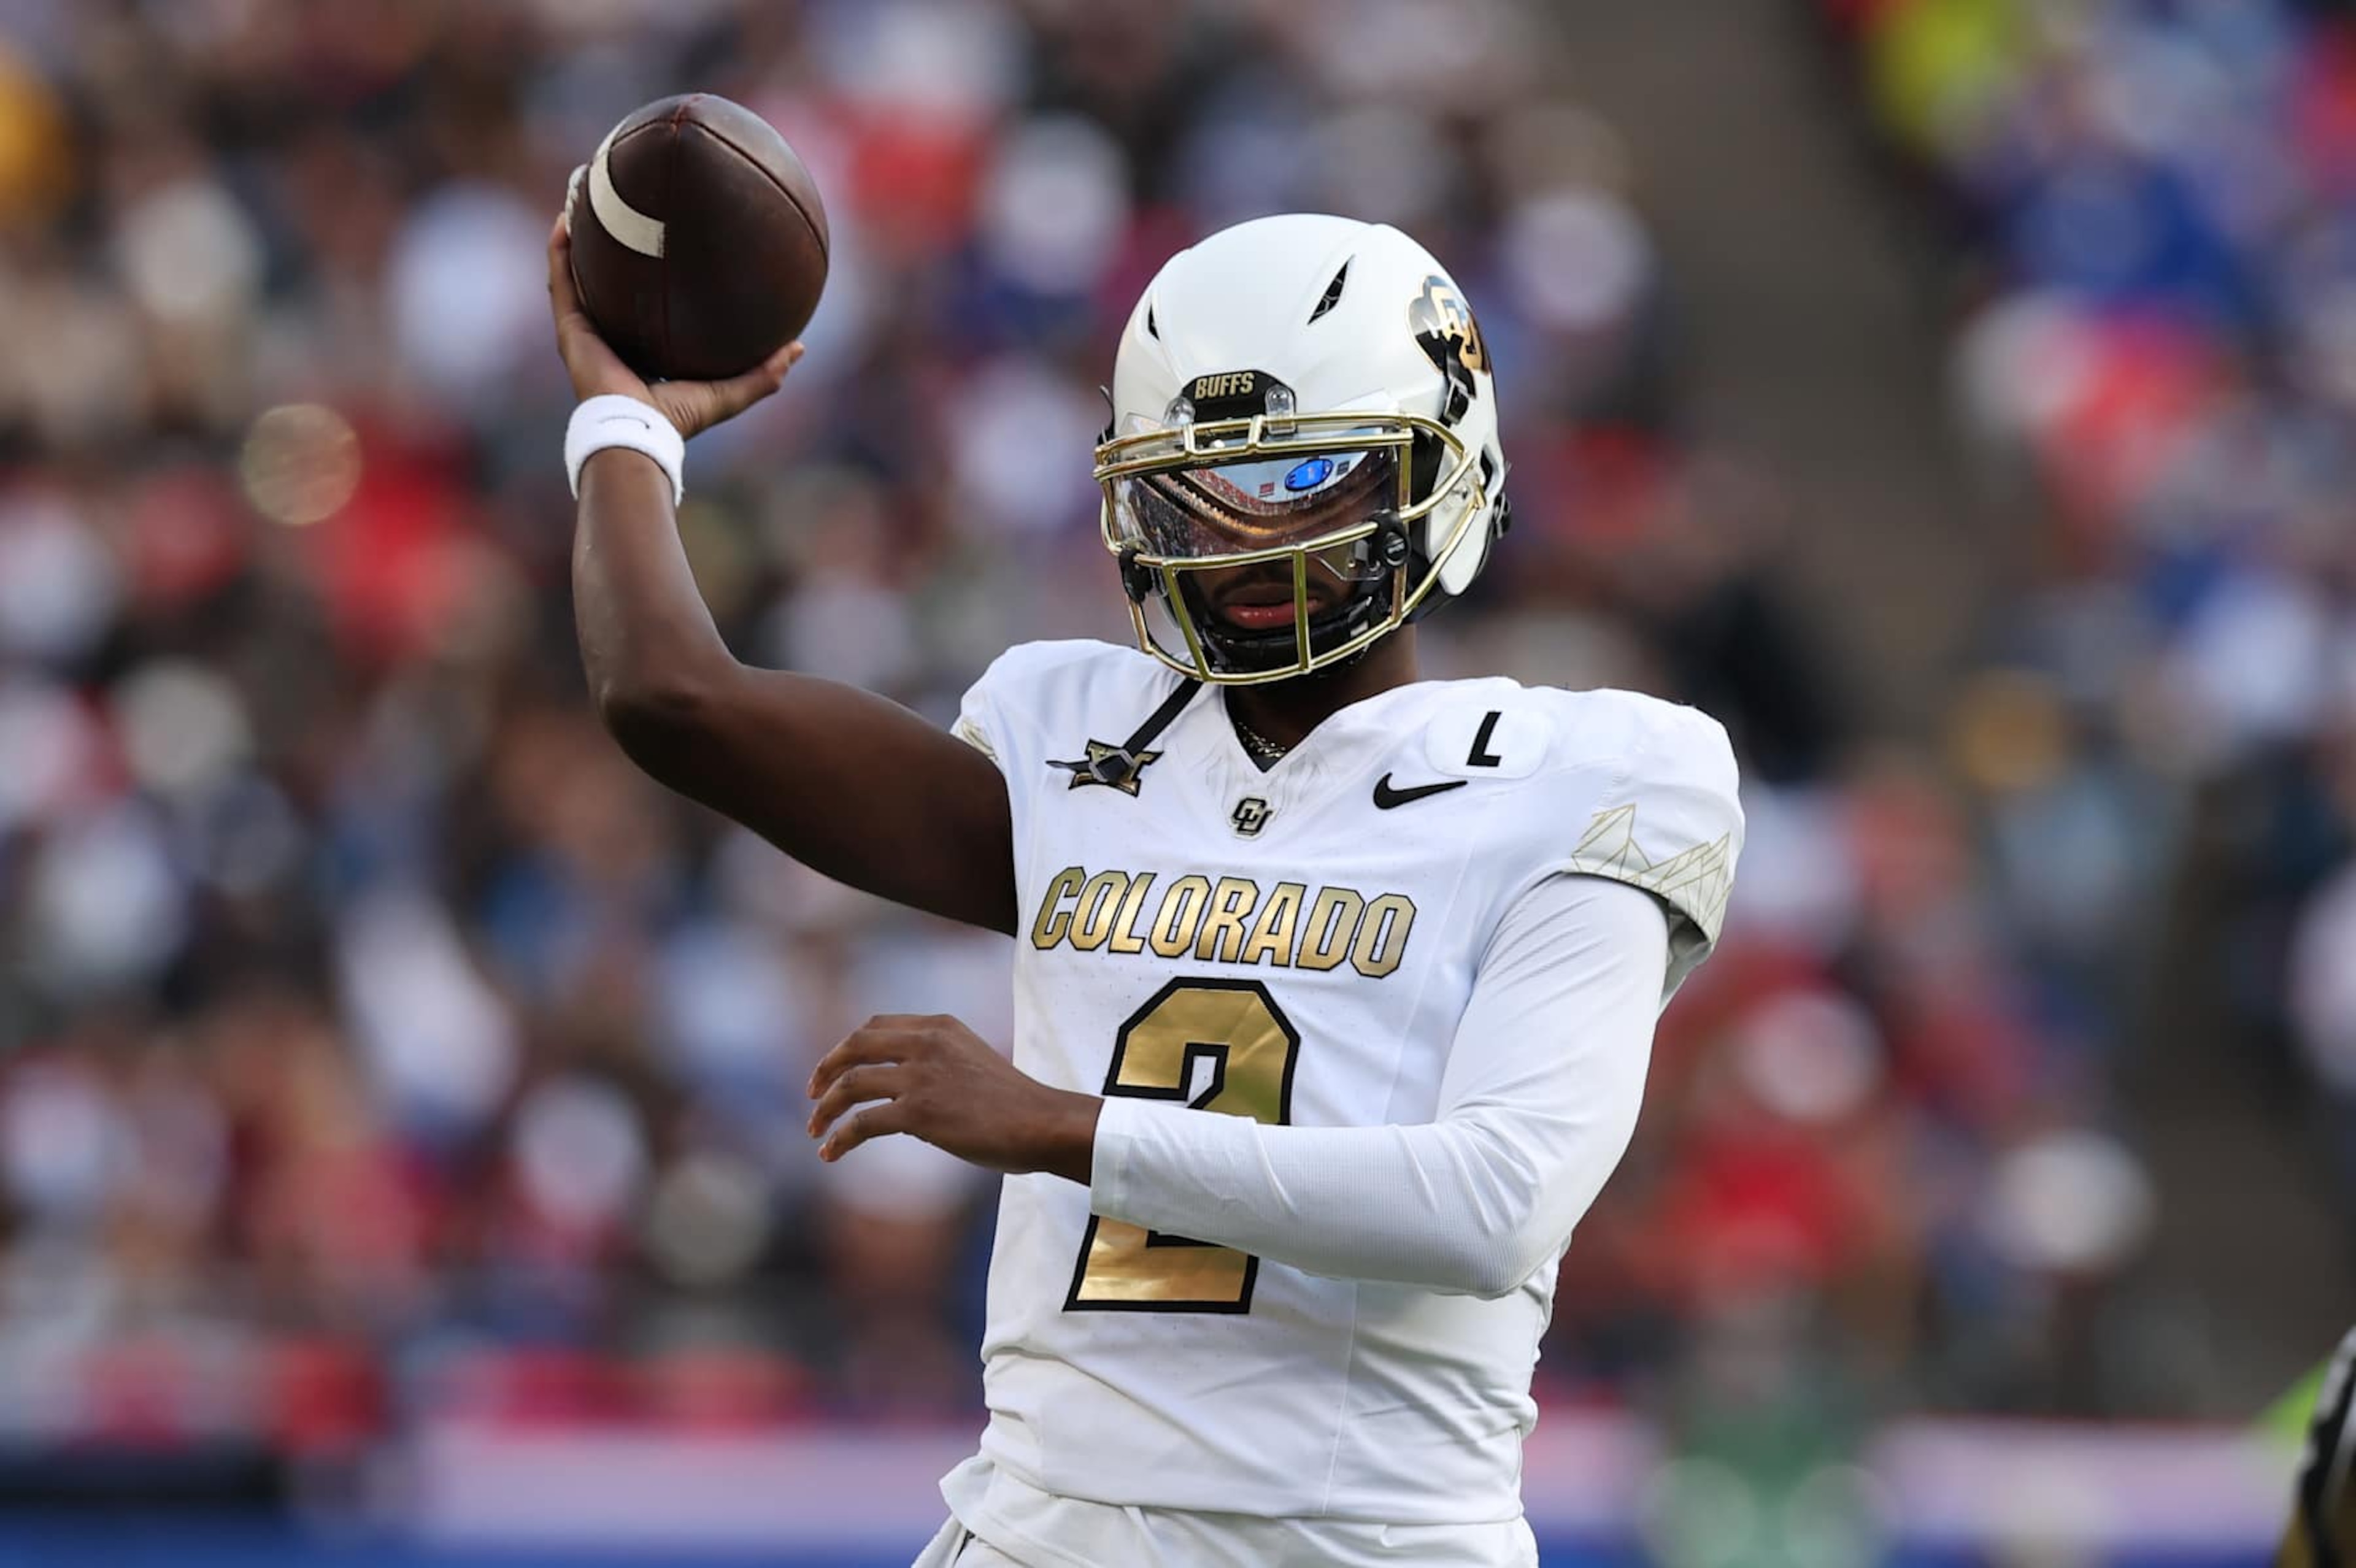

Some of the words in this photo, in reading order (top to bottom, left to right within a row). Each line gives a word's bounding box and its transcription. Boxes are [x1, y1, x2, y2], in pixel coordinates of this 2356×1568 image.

[1194, 372, 1255, 400] BUFFS
[1466, 711, 1502, 767] L
[1232, 797, 1273, 836] CU
[1031, 867, 1417, 978] COLORADO
[1063, 977, 1300, 1313] 2
